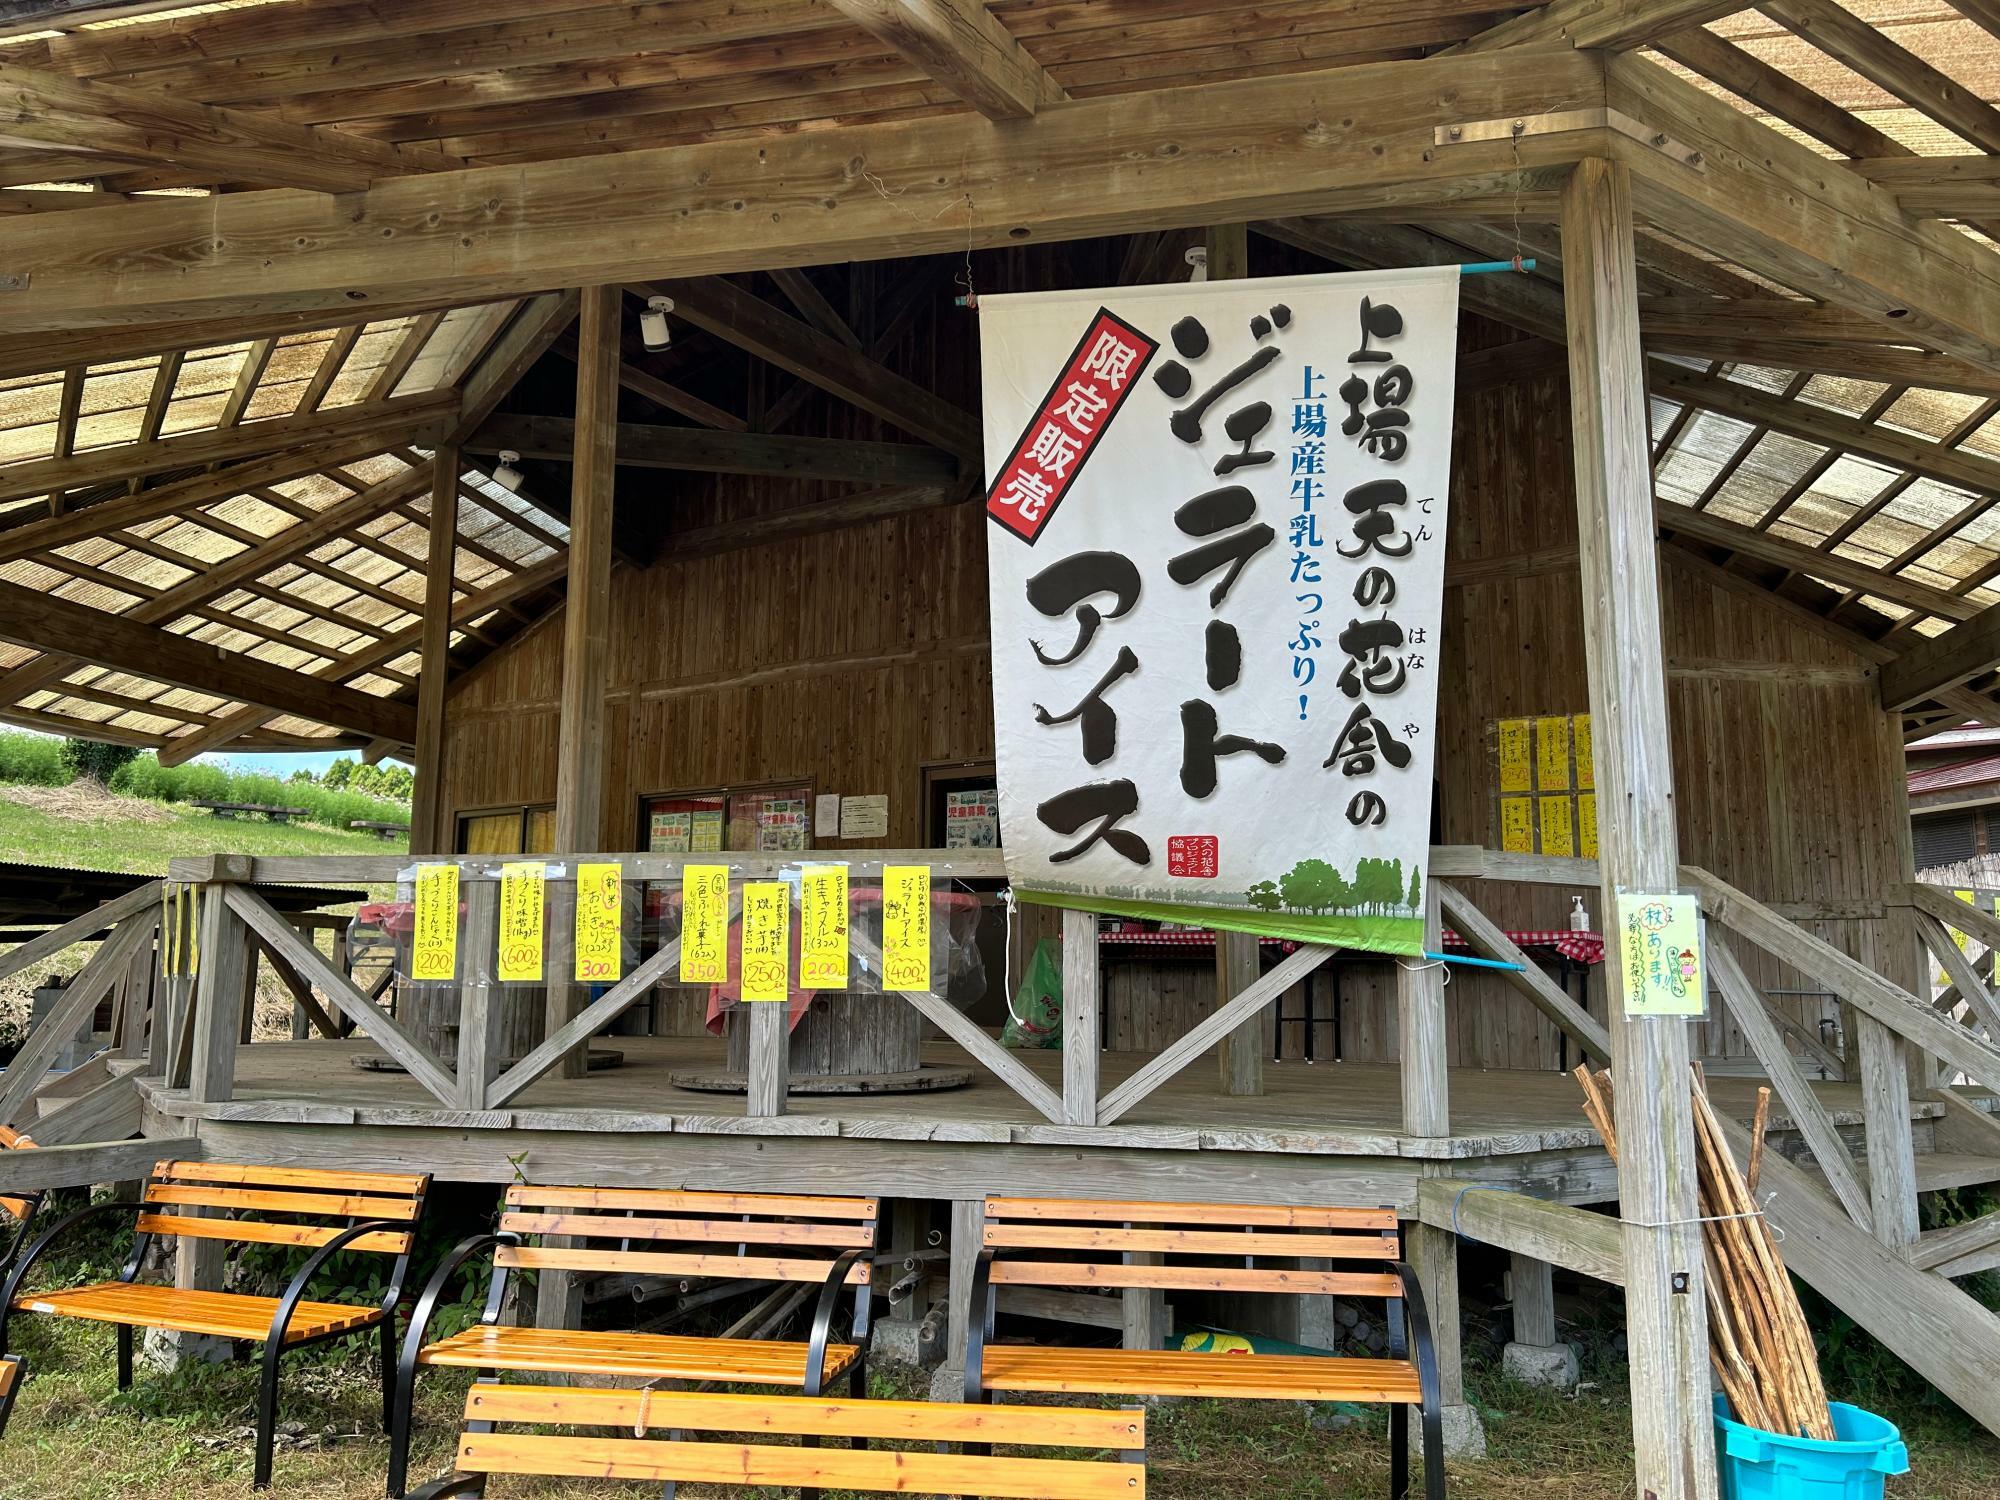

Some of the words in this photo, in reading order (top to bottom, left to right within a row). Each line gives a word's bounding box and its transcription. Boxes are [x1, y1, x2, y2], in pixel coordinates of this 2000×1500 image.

[998, 329, 1139, 524] 限定販売
[1287, 365, 1328, 721] 上場産牛乳たっぷり！
[1416, 496, 1435, 543] てん
[1152, 303, 1293, 800] ジェラート
[1407, 626, 1427, 670] はな
[1025, 550, 1151, 866] アイス
[1402, 721, 1420, 739] や
[589, 891, 602, 944] おにぎり
[606, 876, 617, 907] 新米
[816, 877, 830, 937] 生キャラメル
[755, 898, 773, 946] 焼き芋
